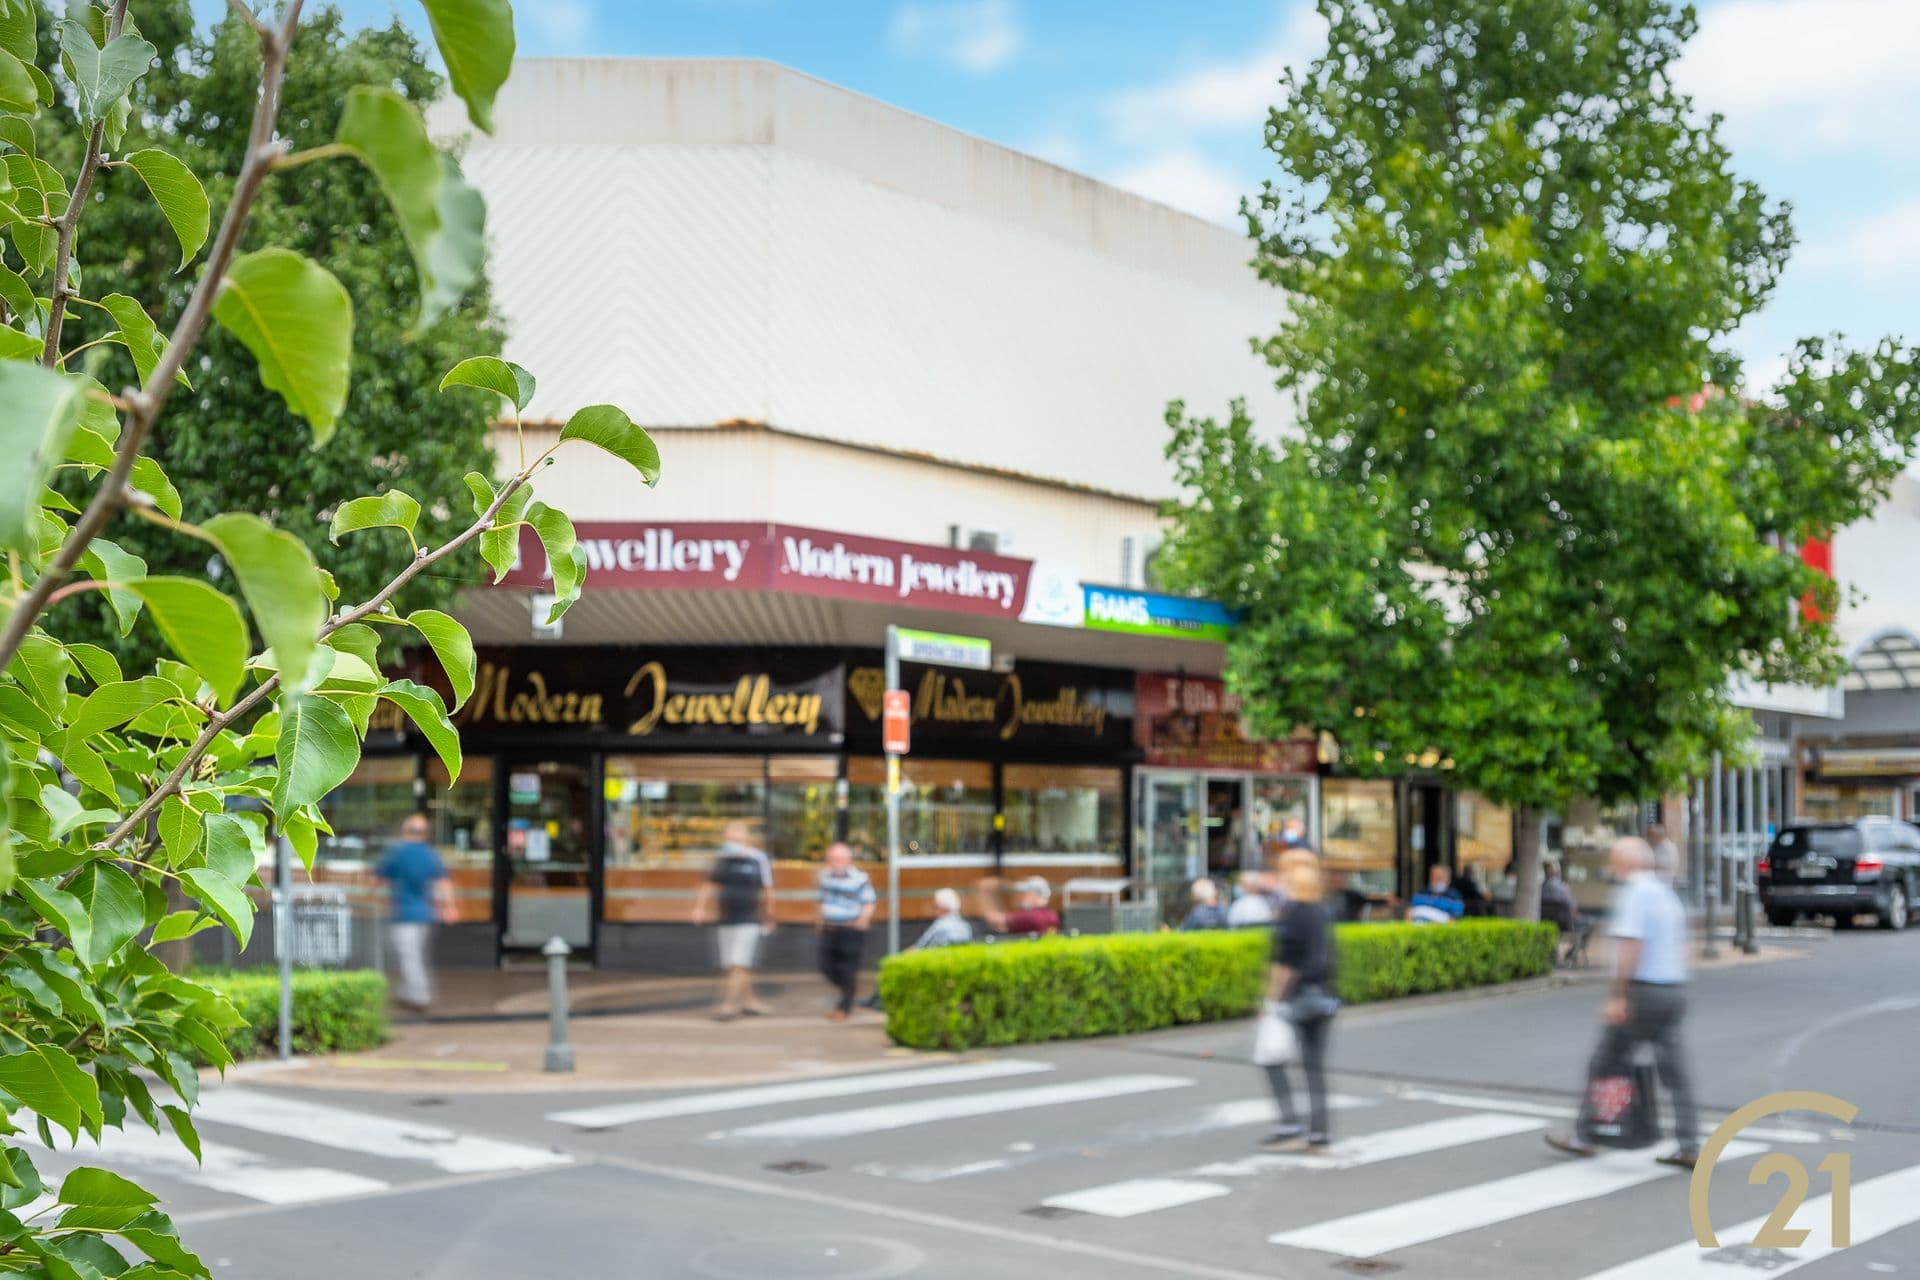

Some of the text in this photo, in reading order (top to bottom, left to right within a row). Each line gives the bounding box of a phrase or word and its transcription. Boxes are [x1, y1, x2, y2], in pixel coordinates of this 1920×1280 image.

[543, 528, 750, 582] wellery
[781, 536, 1019, 609] Modern Jewellery
[460, 662, 603, 726] Modern
[623, 661, 822, 735] Jewellery
